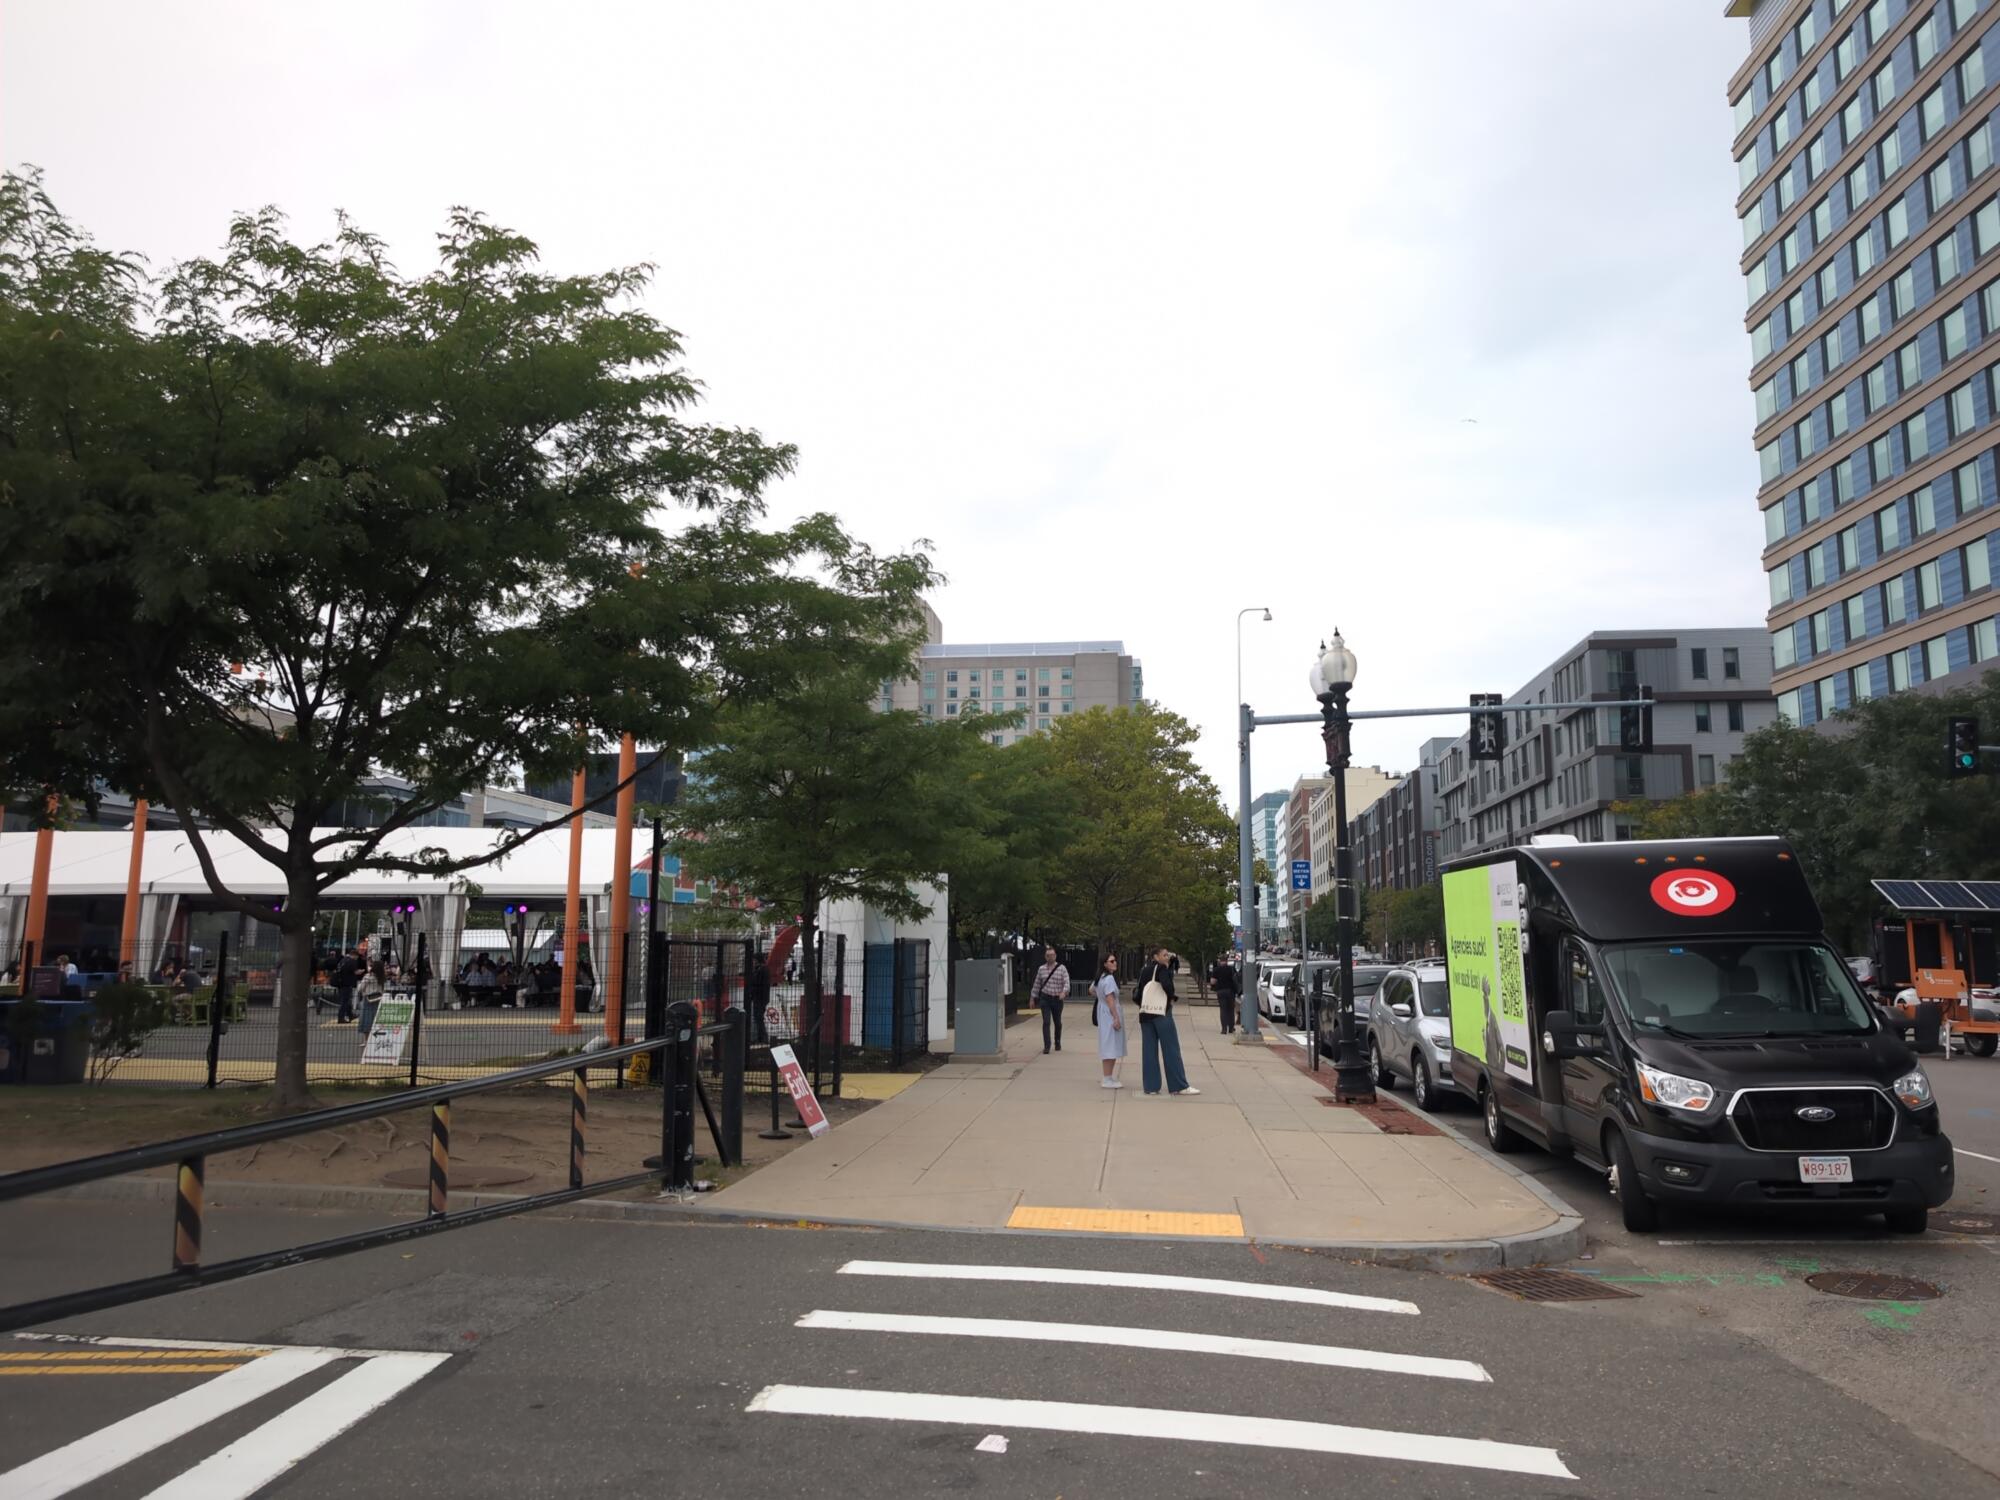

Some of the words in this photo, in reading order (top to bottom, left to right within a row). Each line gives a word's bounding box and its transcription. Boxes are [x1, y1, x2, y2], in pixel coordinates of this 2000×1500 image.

[1451, 936, 1472, 959] Agencies
[1472, 936, 1487, 957] suck!
[785, 1071, 809, 1100] Exit
